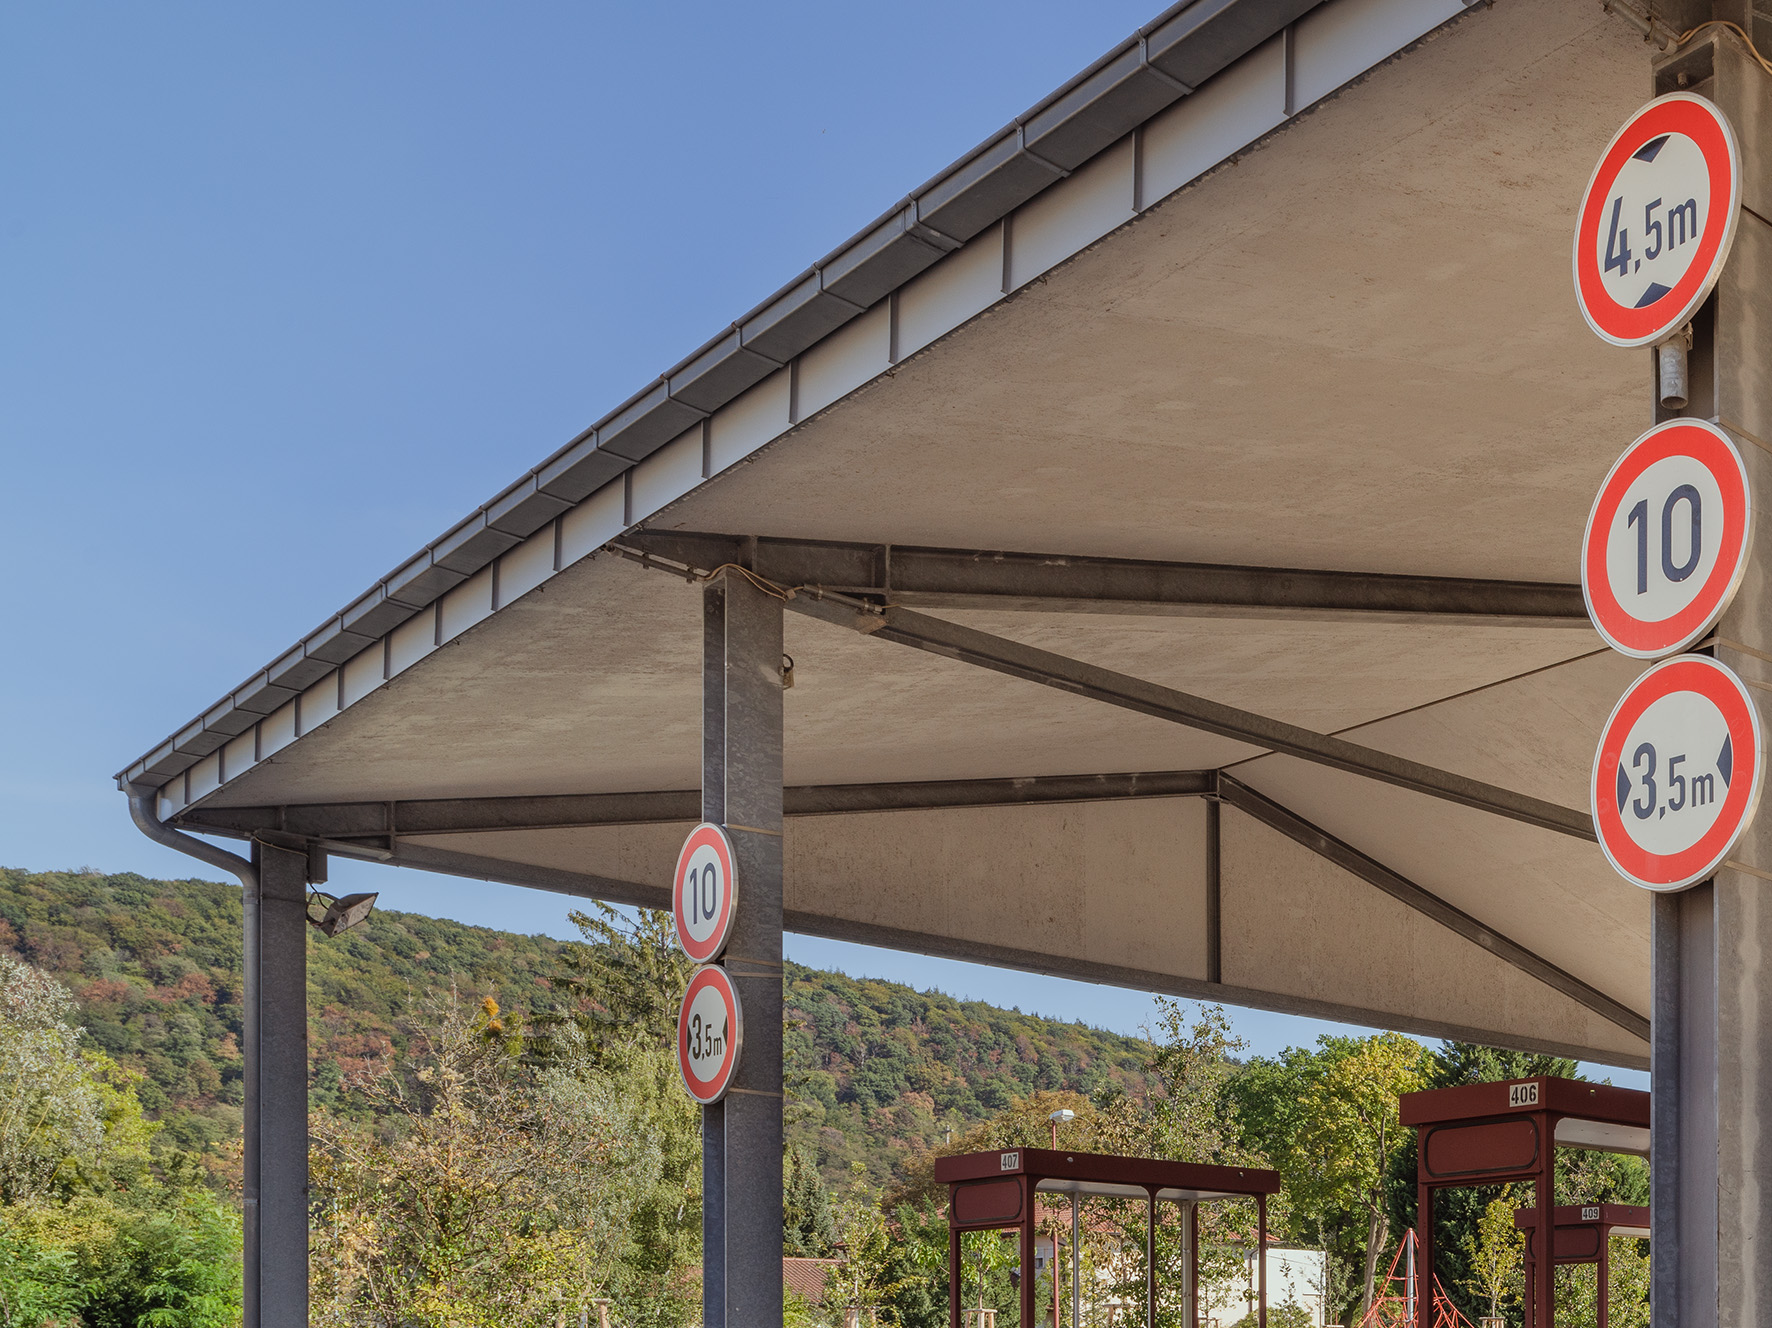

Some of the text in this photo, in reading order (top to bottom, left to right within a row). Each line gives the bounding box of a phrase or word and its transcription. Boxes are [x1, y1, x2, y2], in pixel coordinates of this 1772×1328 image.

[1627, 484, 1702, 595] 10
[690, 862, 716, 925] 10
[1511, 1084, 1537, 1104] 406
[1002, 1154, 1018, 1169] 407
[1583, 1208, 1598, 1219] 409
